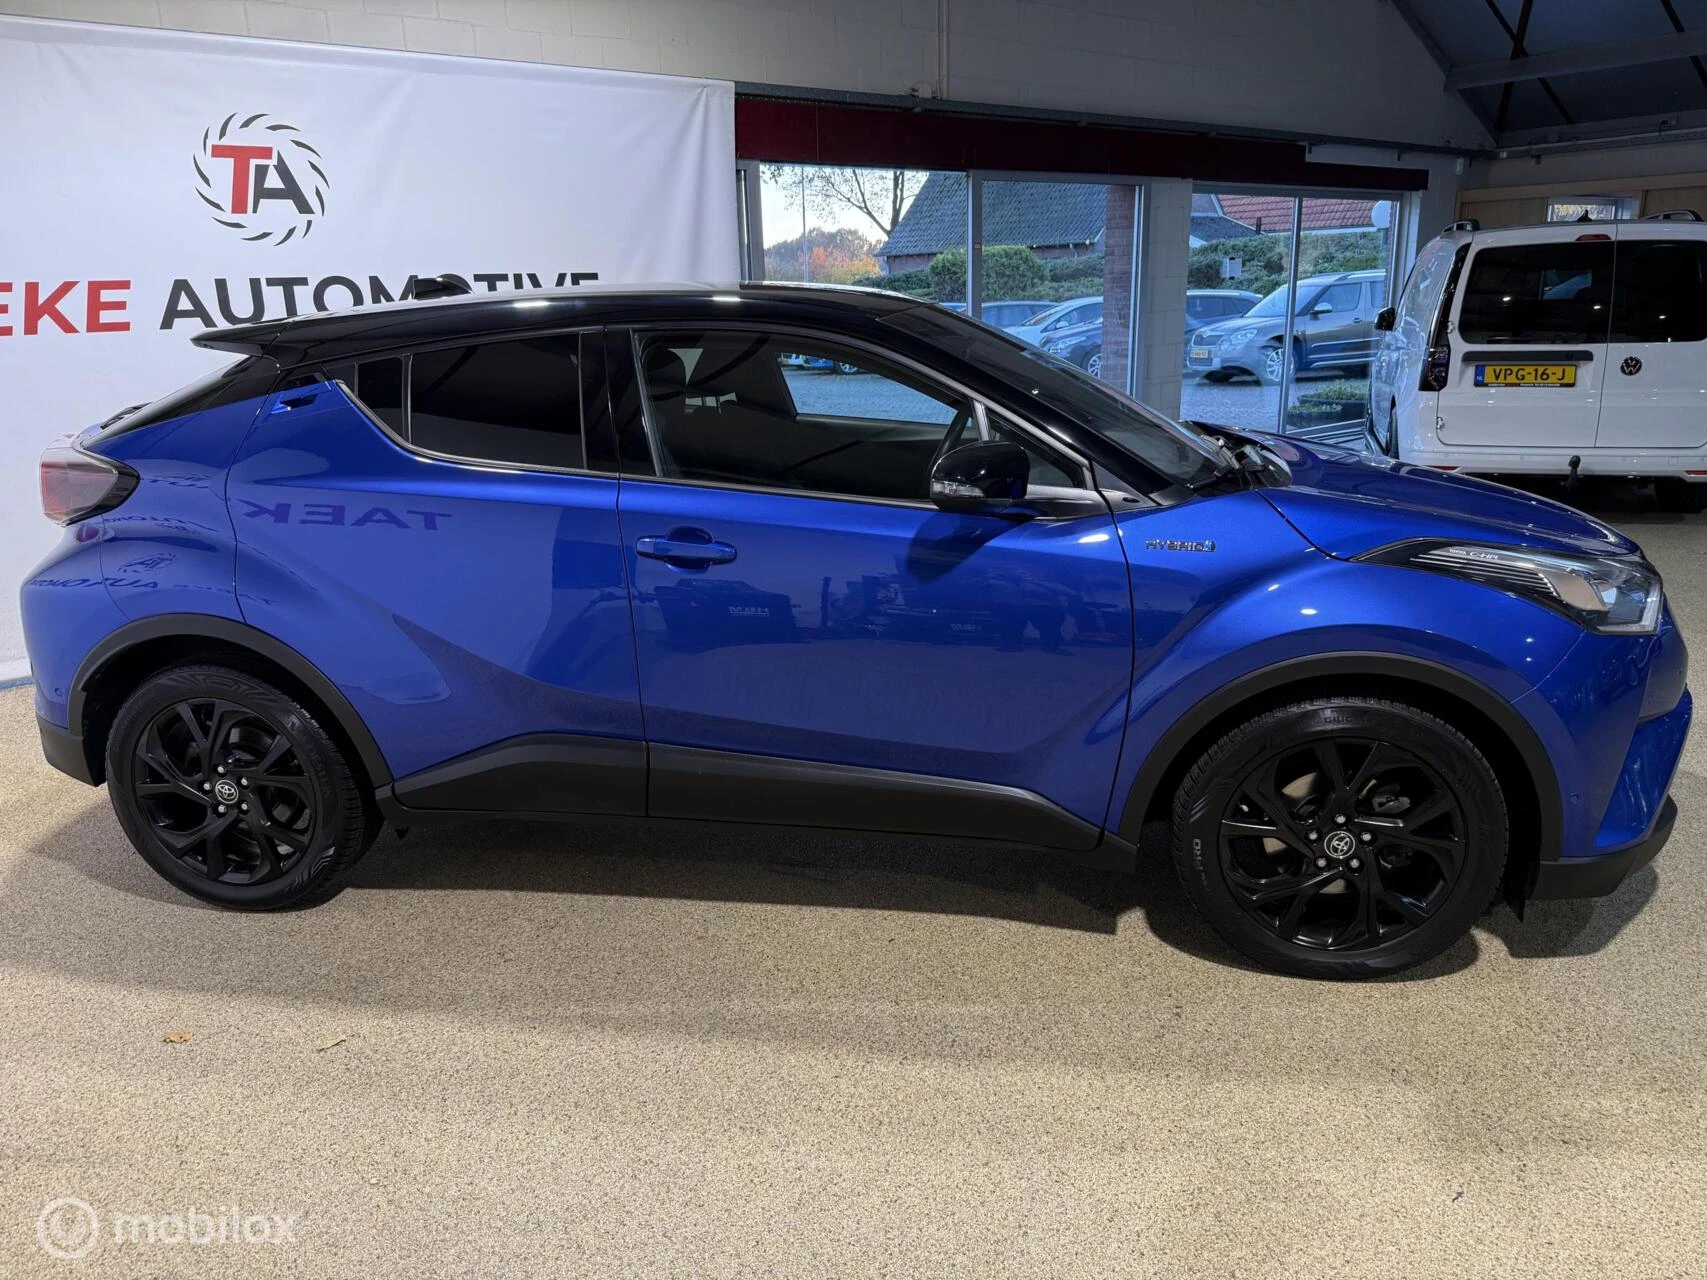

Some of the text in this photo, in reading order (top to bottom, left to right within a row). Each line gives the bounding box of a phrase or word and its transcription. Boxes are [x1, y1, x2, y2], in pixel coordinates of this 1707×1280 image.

[210, 144, 316, 215] TA
[159, 272, 599, 330] AUTOMT
[1493, 368, 1566, 381] VPG-16-J
[1145, 539, 1205, 552] HYBRID
